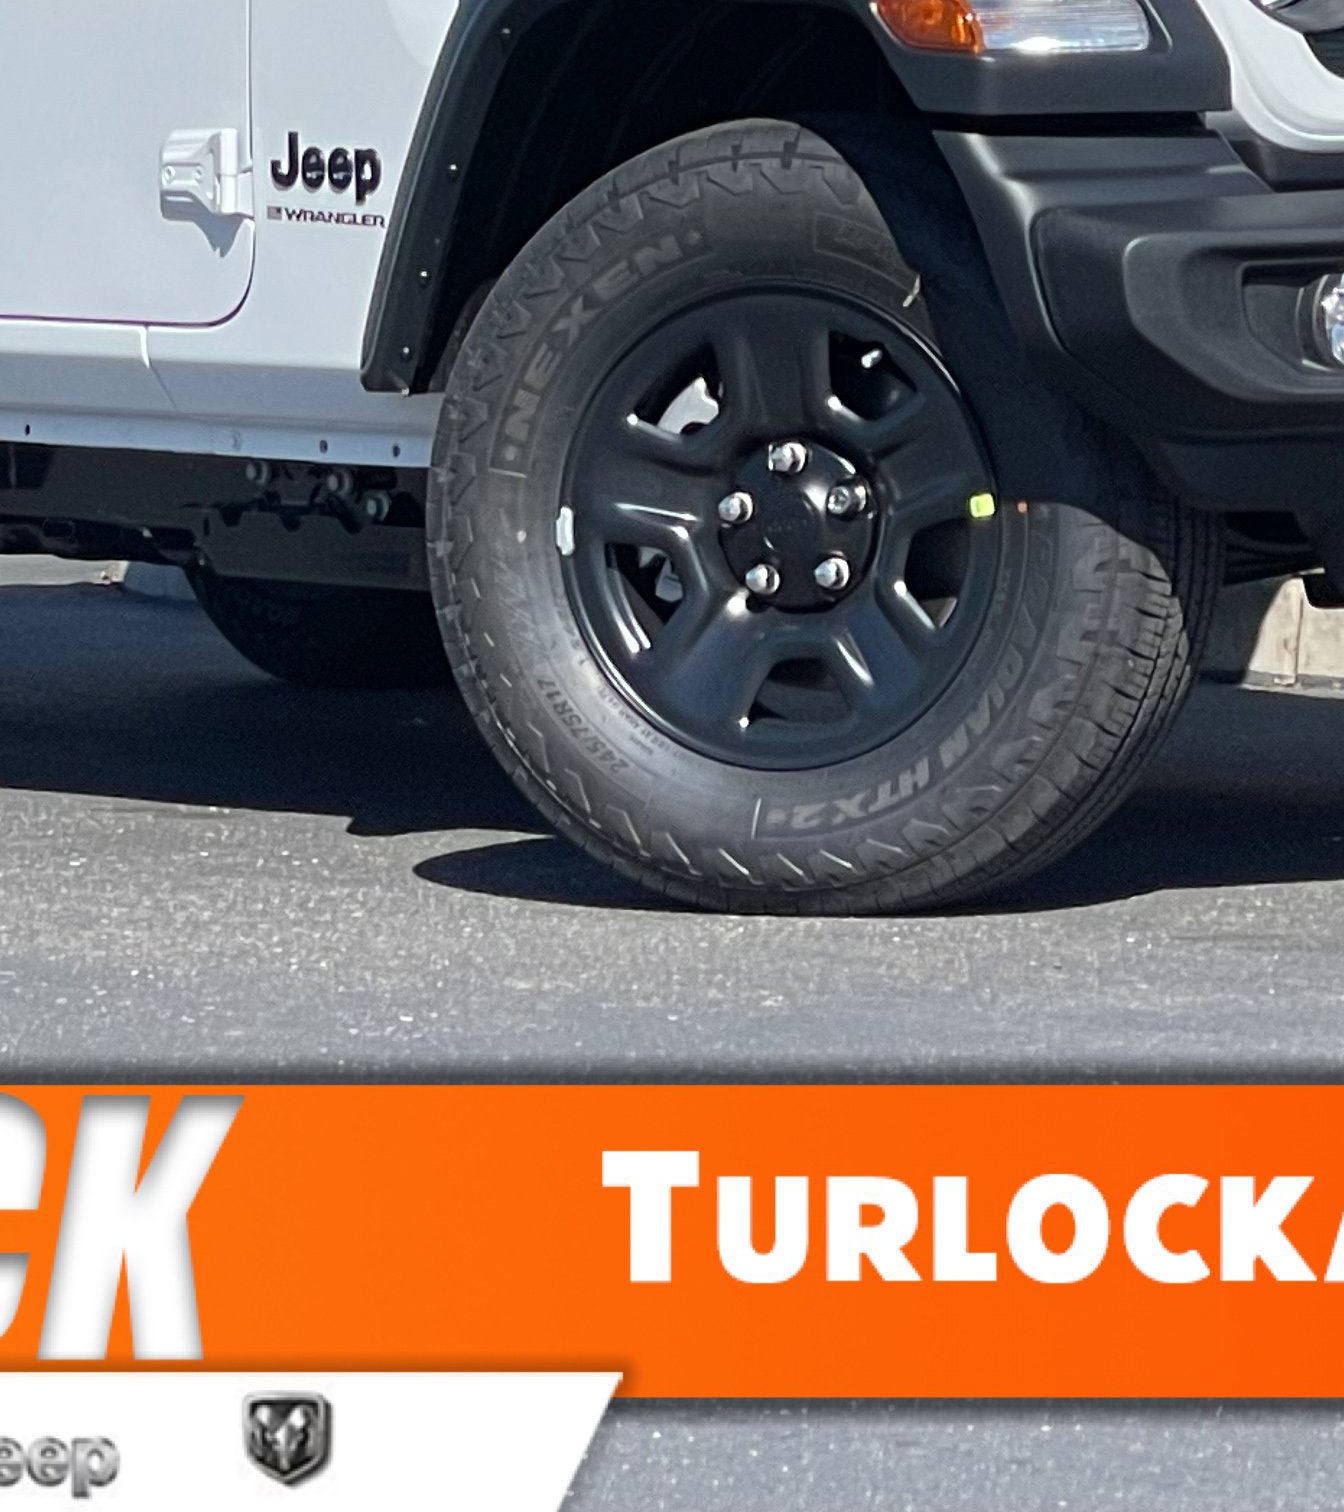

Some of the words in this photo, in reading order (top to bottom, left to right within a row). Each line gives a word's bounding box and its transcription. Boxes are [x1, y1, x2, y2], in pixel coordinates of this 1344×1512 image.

[270, 131, 381, 206] Jeep
[284, 207, 385, 228] WRANGLER
[503, 230, 680, 441] NEXEN
